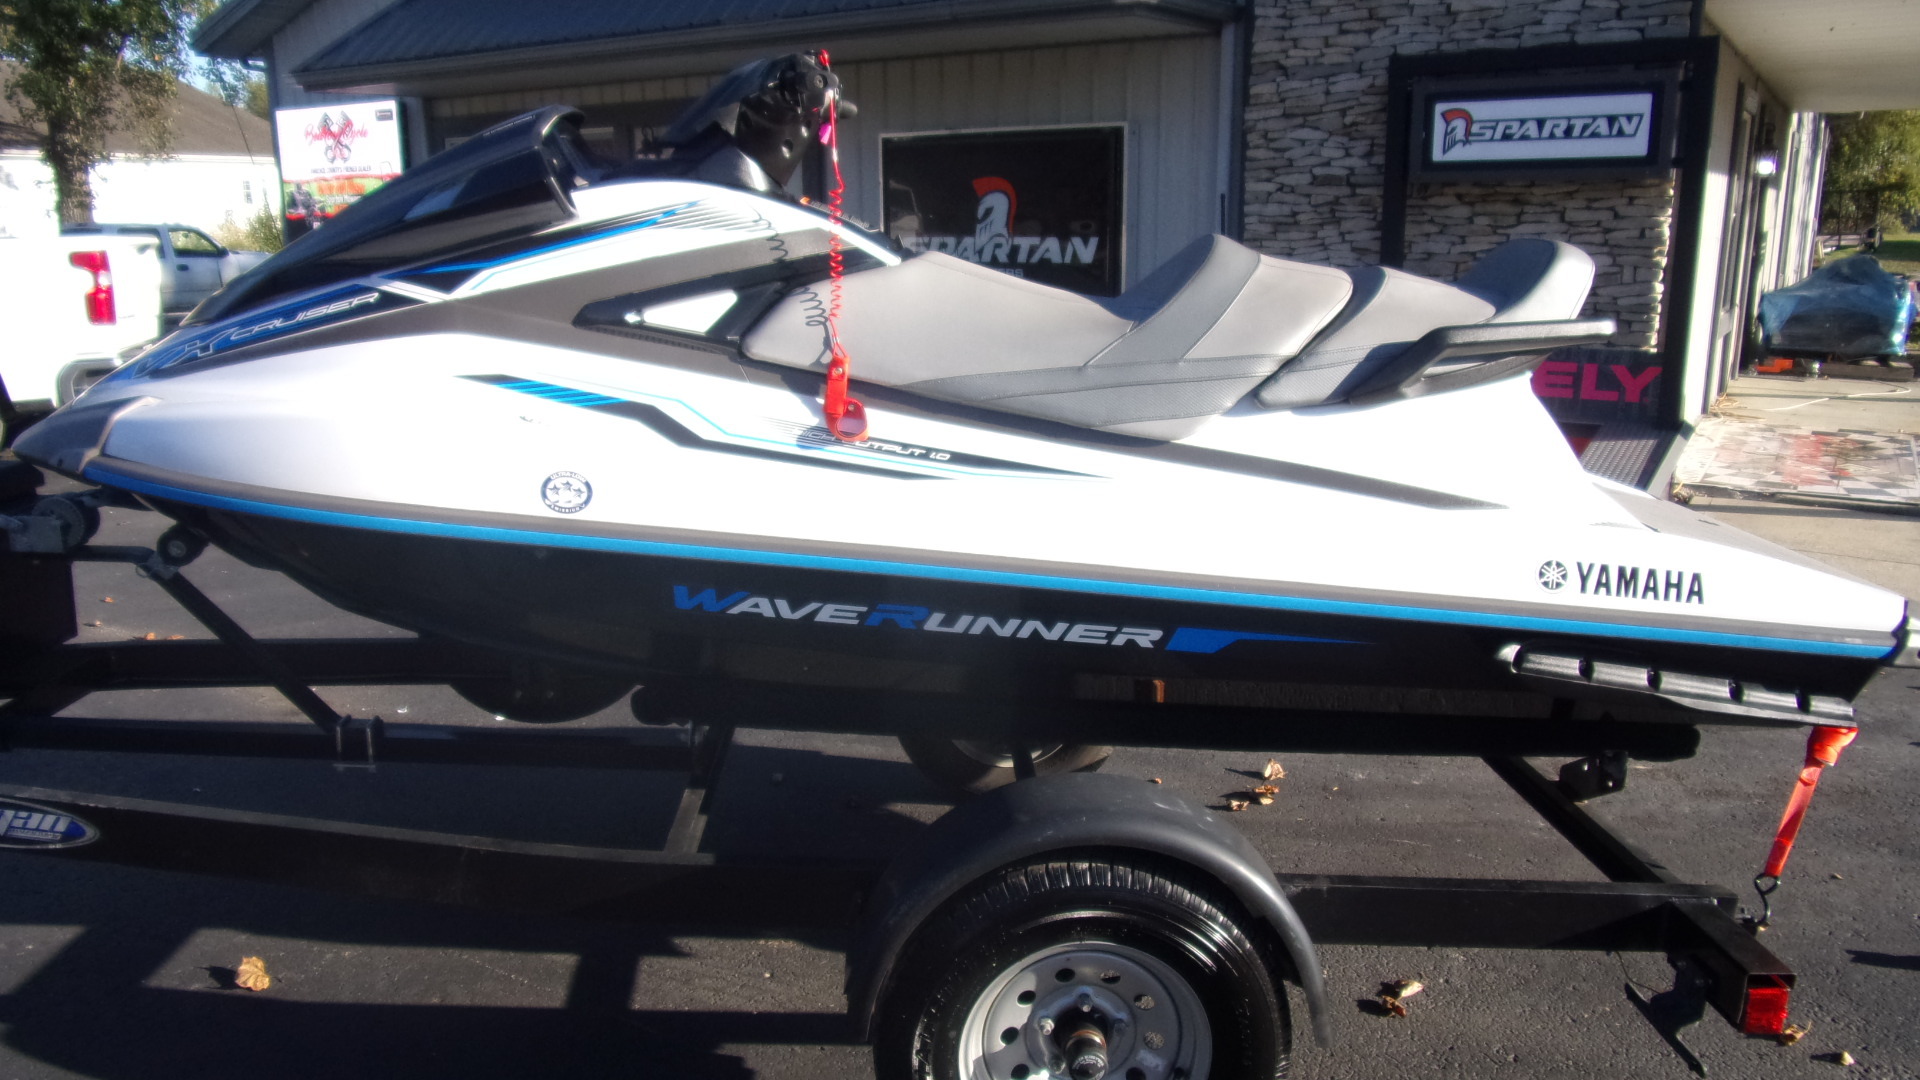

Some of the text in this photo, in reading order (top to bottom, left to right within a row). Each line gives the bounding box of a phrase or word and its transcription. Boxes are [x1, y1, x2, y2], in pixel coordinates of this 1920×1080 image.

[1470, 114, 1642, 141] SPARTAN
[902, 235, 1099, 264] SPARTAN
[229, 292, 380, 341] CRUISER
[1576, 561, 1705, 605] YAMAHA
[672, 584, 1164, 649] WAVERUNNER
